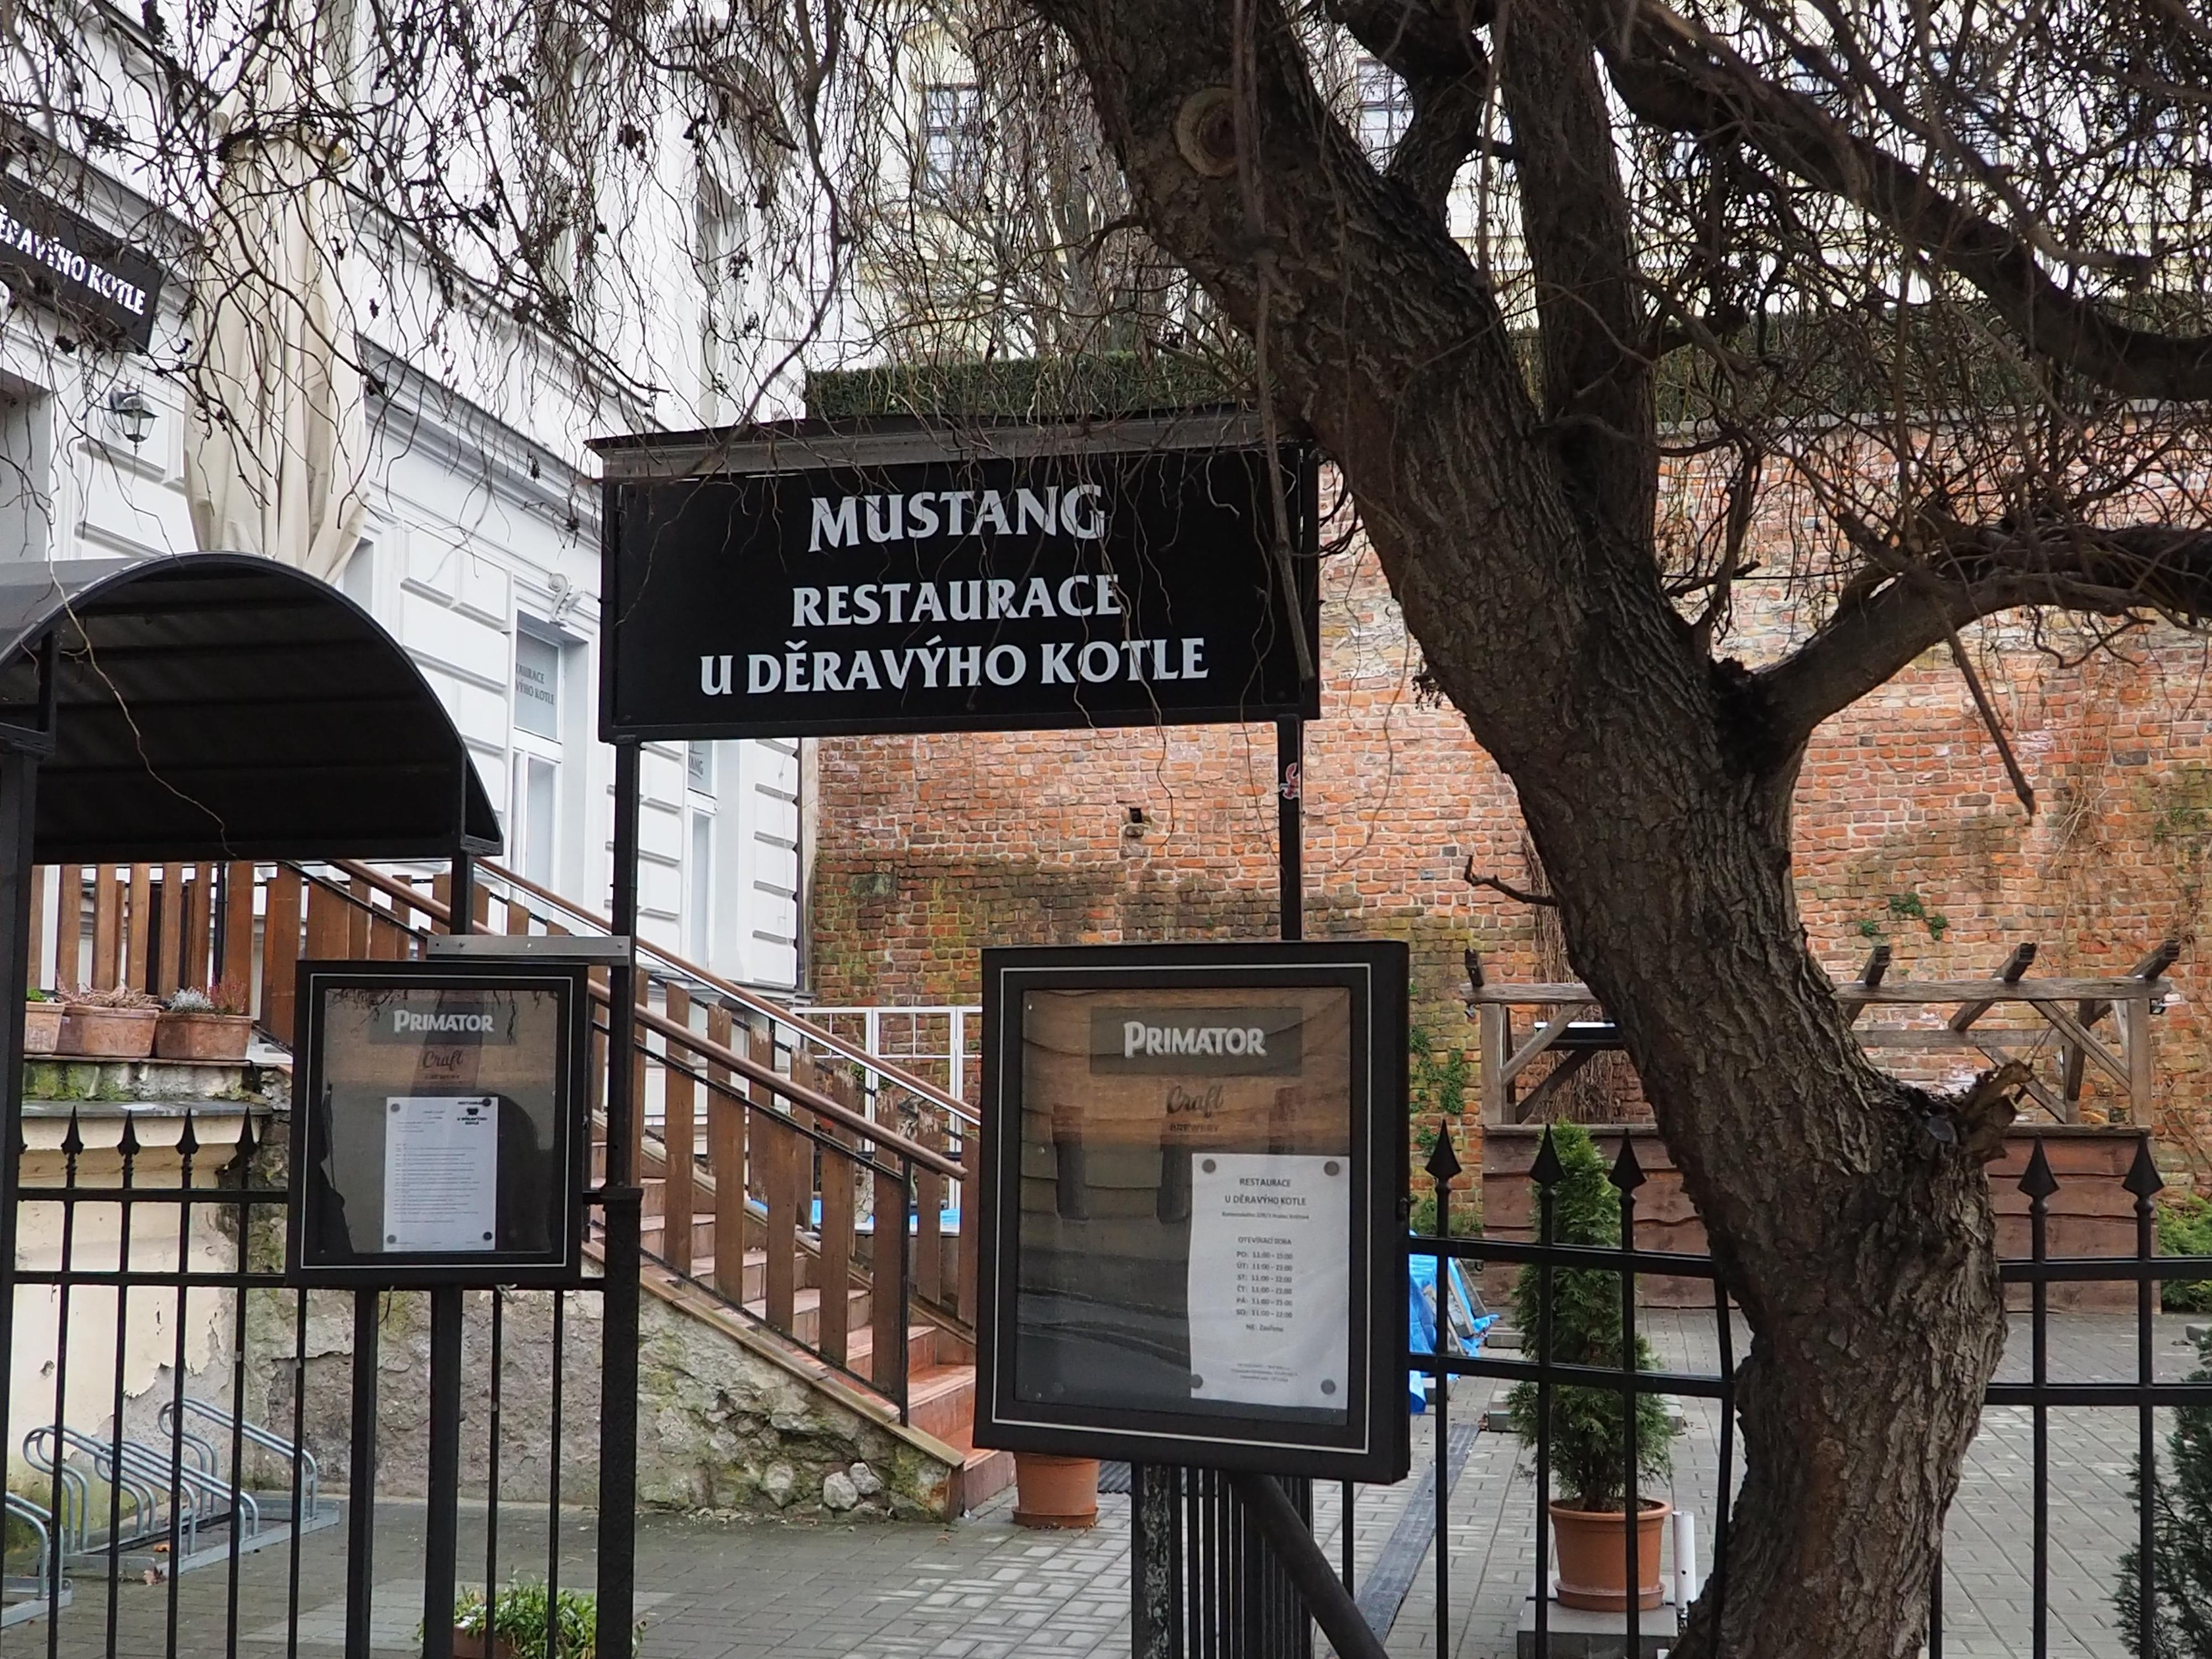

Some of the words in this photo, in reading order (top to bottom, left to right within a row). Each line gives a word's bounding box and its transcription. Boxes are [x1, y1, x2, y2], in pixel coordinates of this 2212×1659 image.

[0, 204, 86, 281] ĚRAVÝHO
[87, 264, 146, 315] KOTLE
[808, 484, 1105, 552] MUSTANG
[792, 575, 1121, 627] RESTAURACE
[701, 655, 733, 695] U
[747, 635, 1026, 693] DĚRAVÝHO
[1041, 638, 1209, 684] KOTLE
[394, 1009, 495, 1033] PRIMATOR
[1124, 1021, 1267, 1059] PRIMATOR
[422, 1050, 463, 1071] Craft
[1166, 1084, 1224, 1119] Craft
[1233, 1194, 1279, 1204] DĚRAVÝHO
[1280, 1197, 1306, 1206] KOTLE
[1239, 1178, 1291, 1187] RESTAURACE
